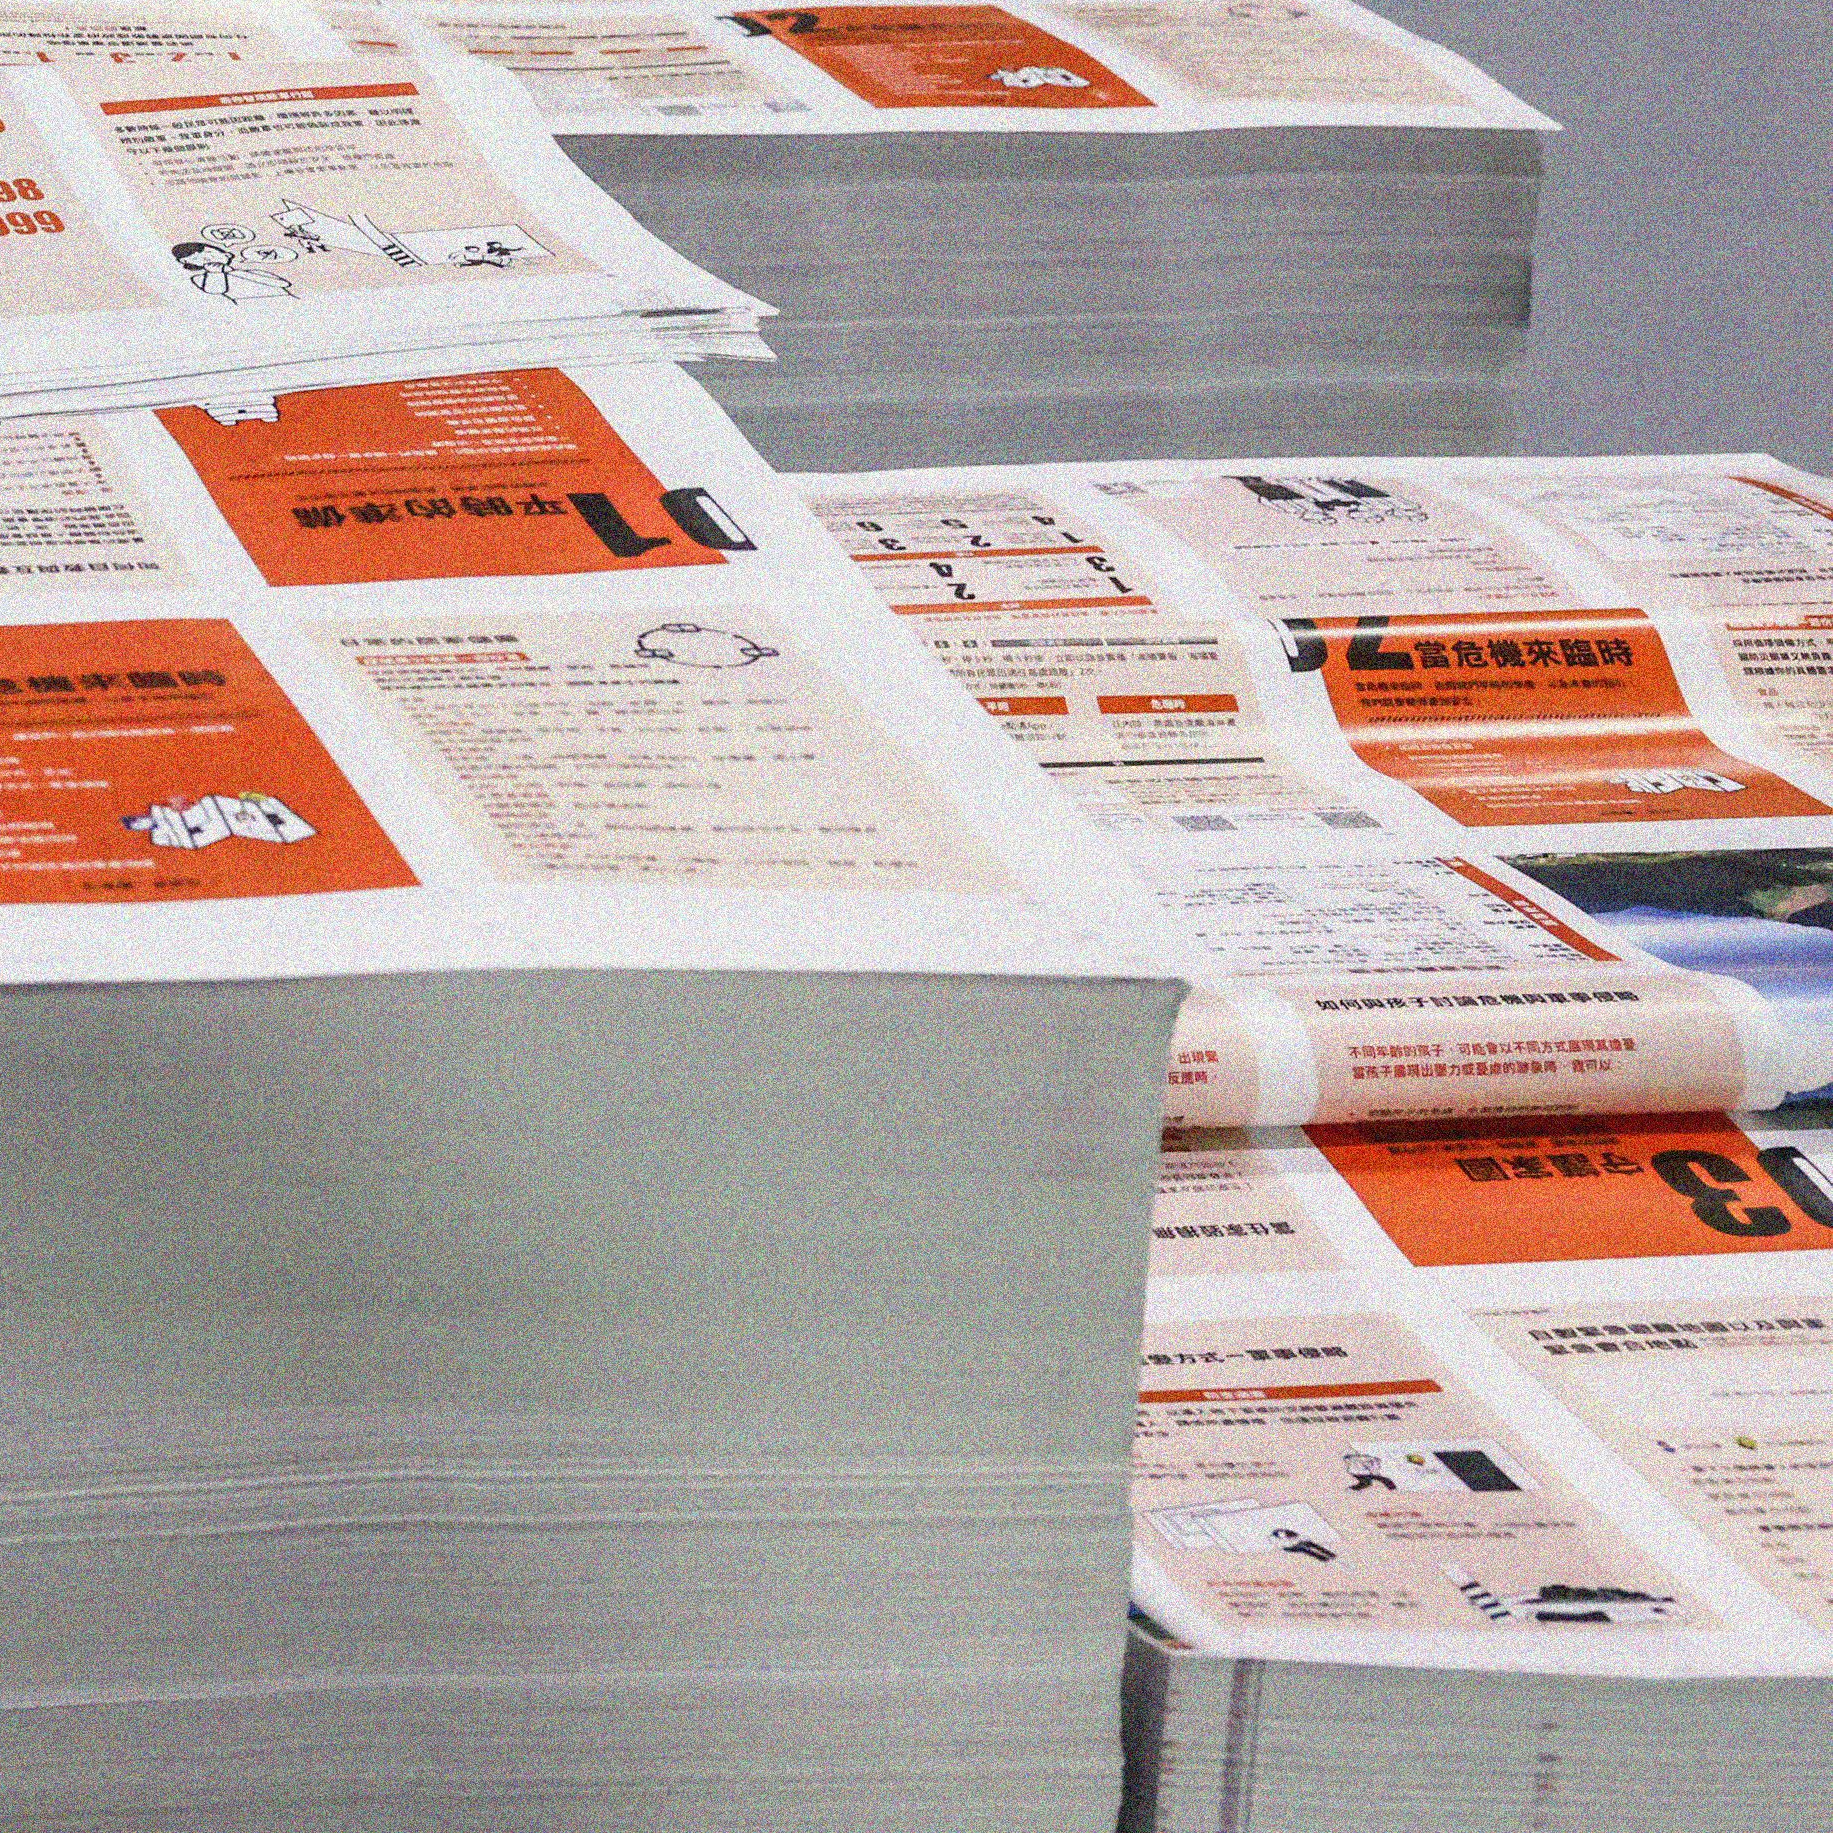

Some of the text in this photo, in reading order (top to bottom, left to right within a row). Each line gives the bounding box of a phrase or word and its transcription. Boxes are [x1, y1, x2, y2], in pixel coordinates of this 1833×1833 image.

[291, 492, 567, 529] 平時的準備
[565, 487, 758, 558] 01
[1412, 639, 1632, 670] 當危機來臨時
[1457, 1152, 1644, 1183] 守護家園
[1653, 1148, 1833, 1239] 03
[1139, 1347, 1347, 1365] 變方式—軍事侵略
